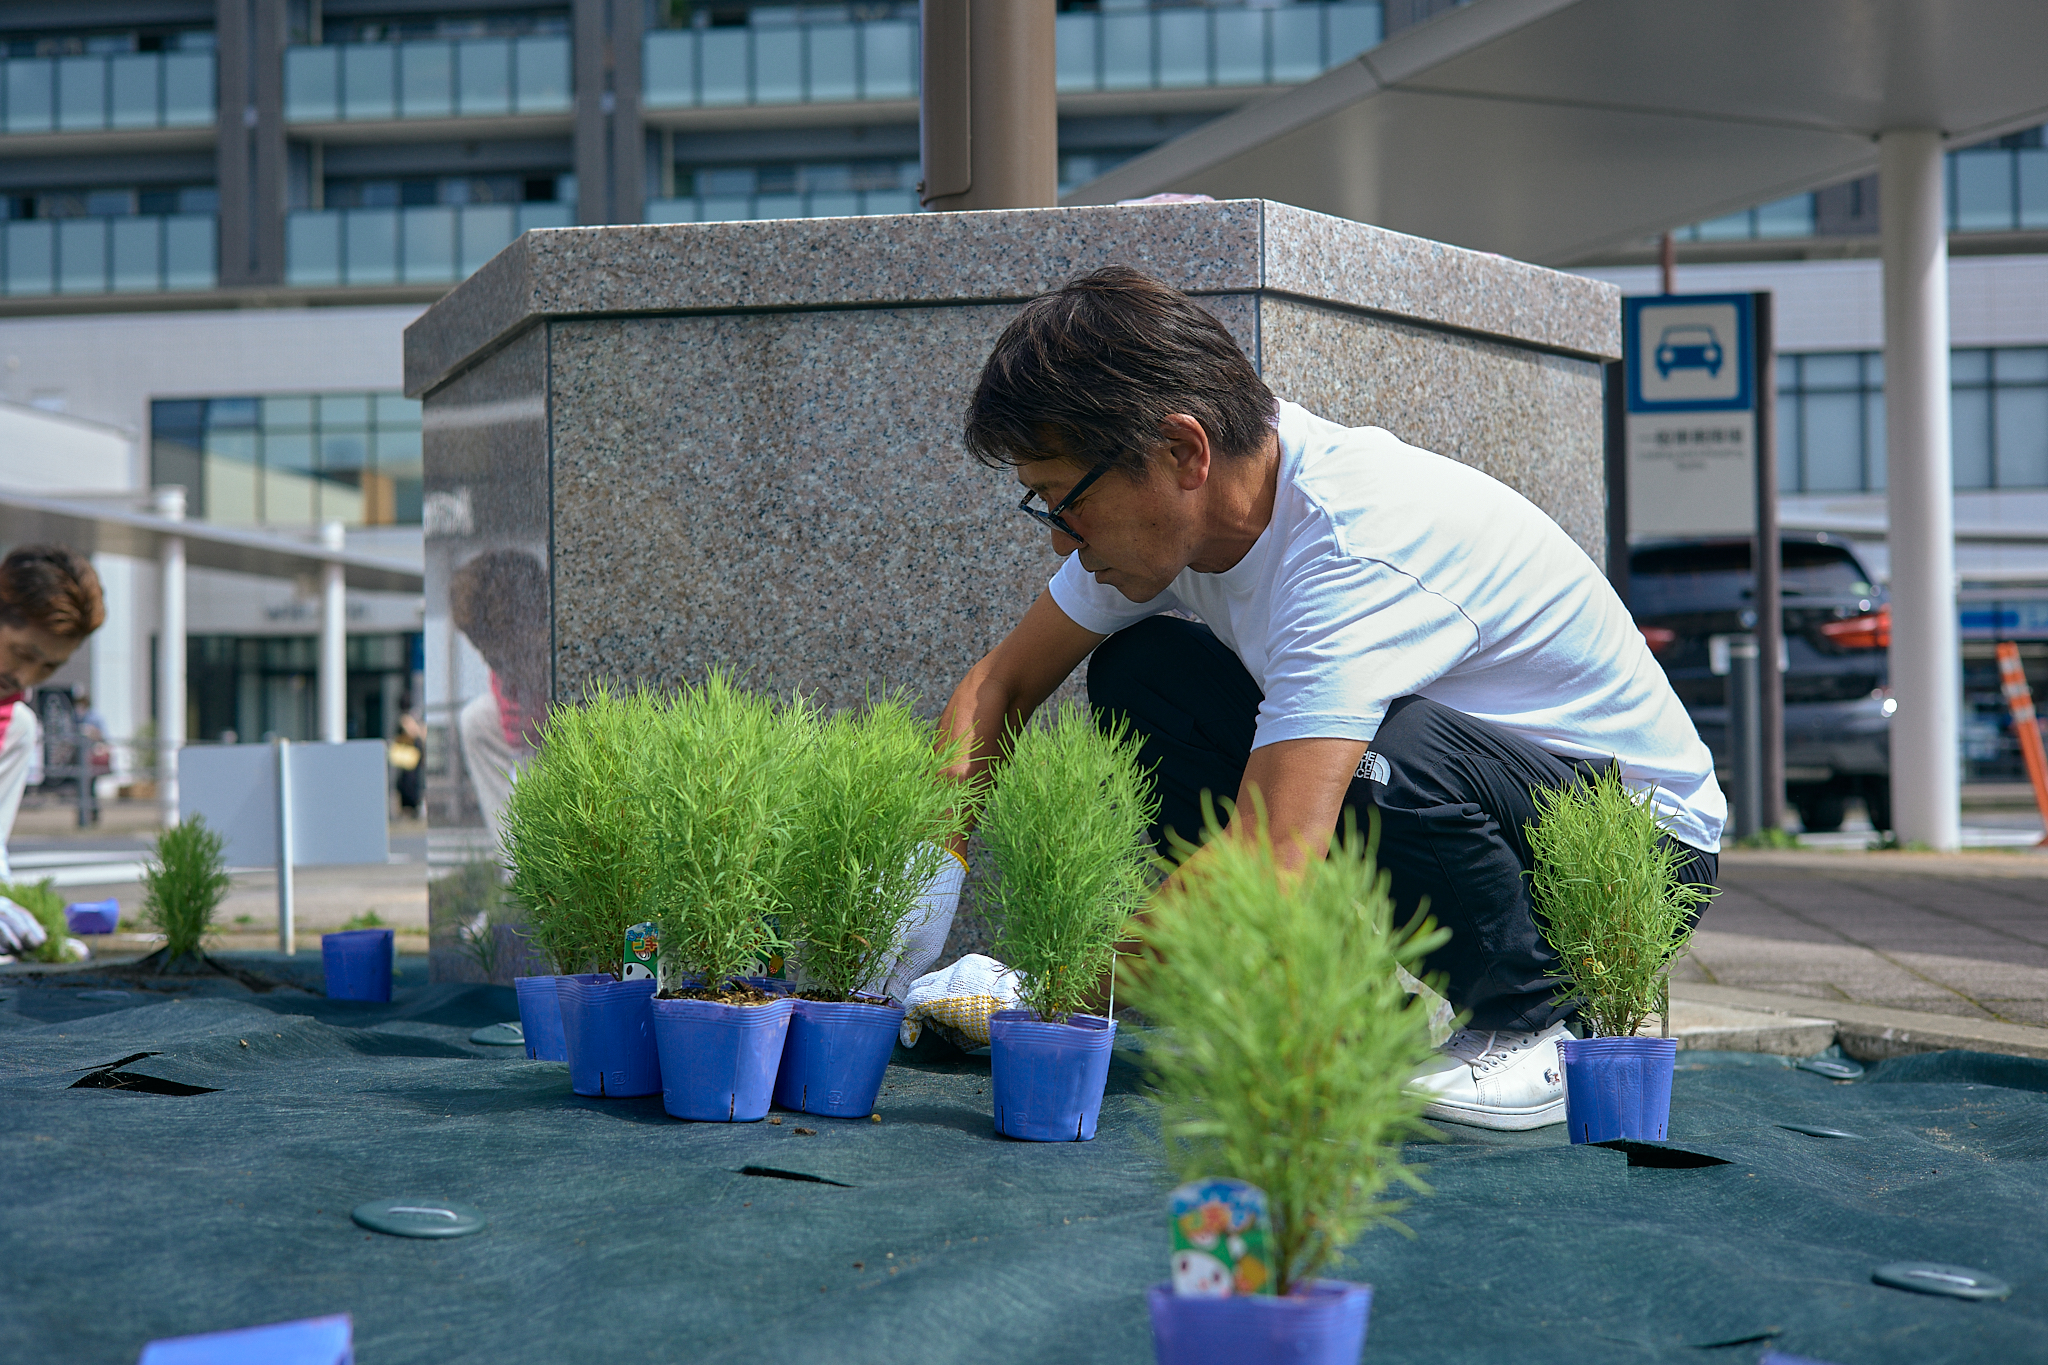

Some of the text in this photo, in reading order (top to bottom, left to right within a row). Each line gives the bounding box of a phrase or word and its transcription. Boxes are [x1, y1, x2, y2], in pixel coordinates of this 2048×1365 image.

[1362, 750, 1377, 762] HE
[1353, 768, 1371, 779] CE
[633, 937, 658, 951] コキ
